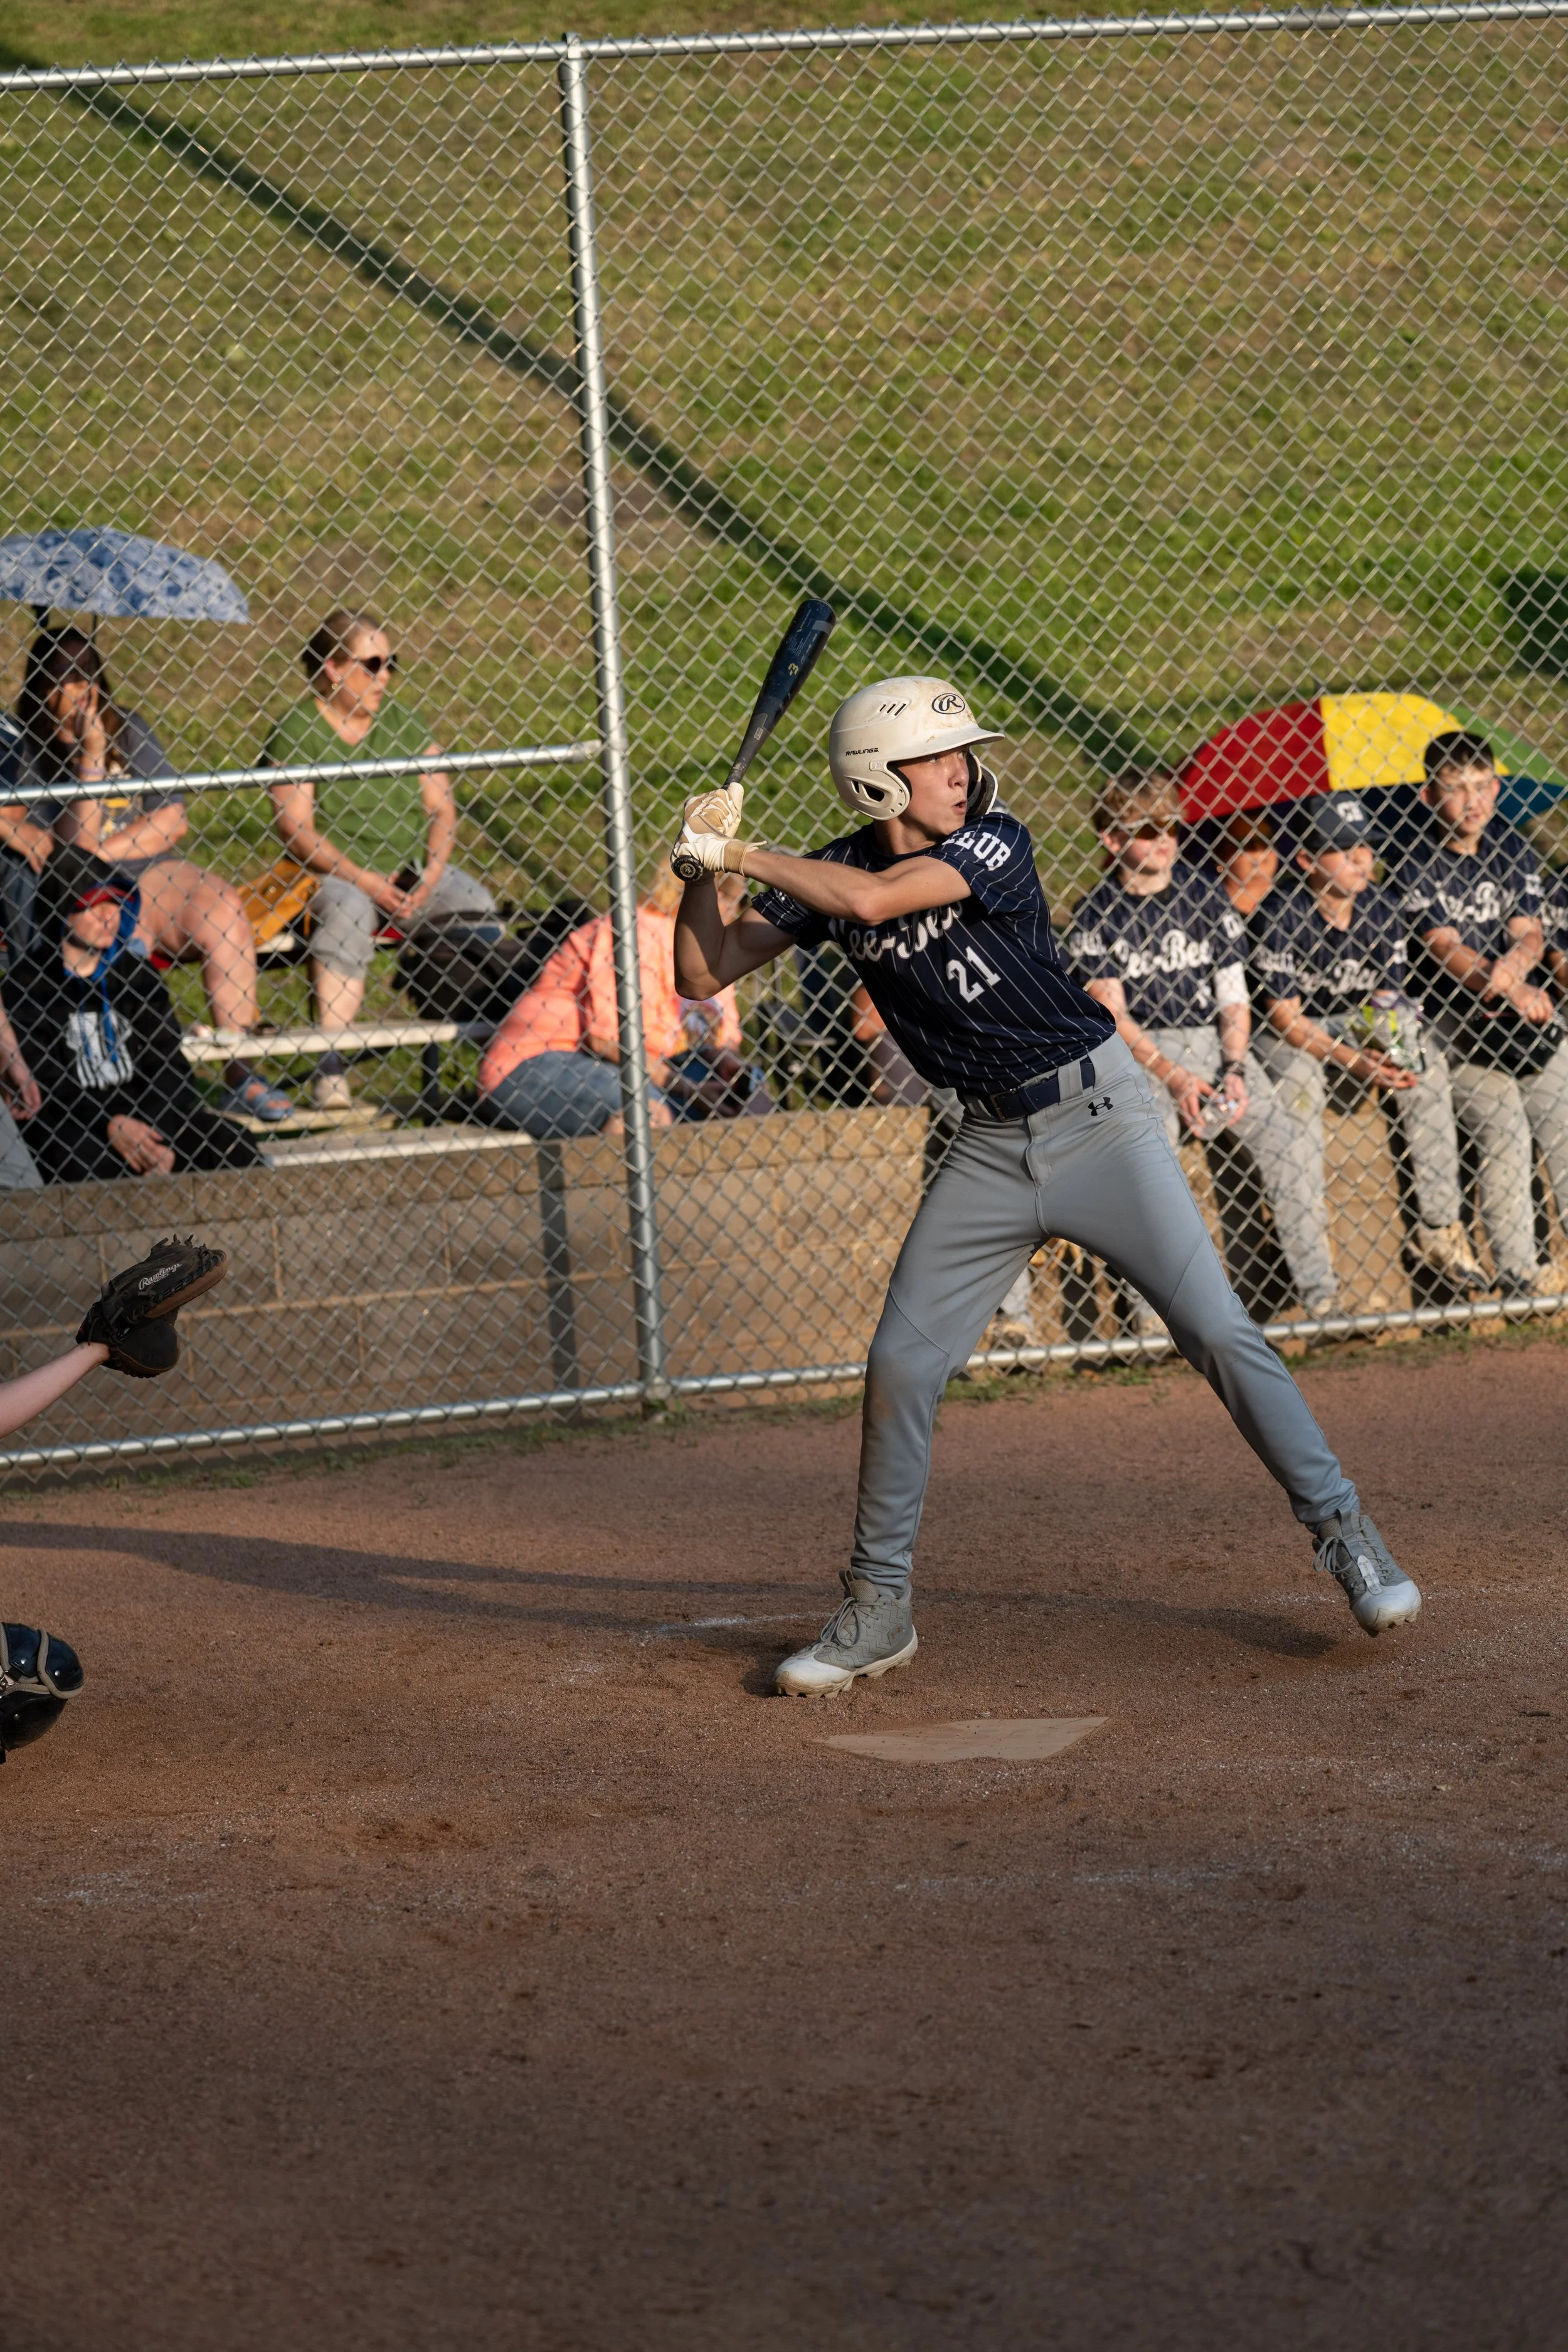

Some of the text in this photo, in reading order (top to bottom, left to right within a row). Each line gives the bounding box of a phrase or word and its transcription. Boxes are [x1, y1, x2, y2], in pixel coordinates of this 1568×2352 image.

[845, 747, 879, 756] RAWLINGS
[946, 946, 1002, 1004] 21
[139, 1263, 183, 1290] Rawlings
